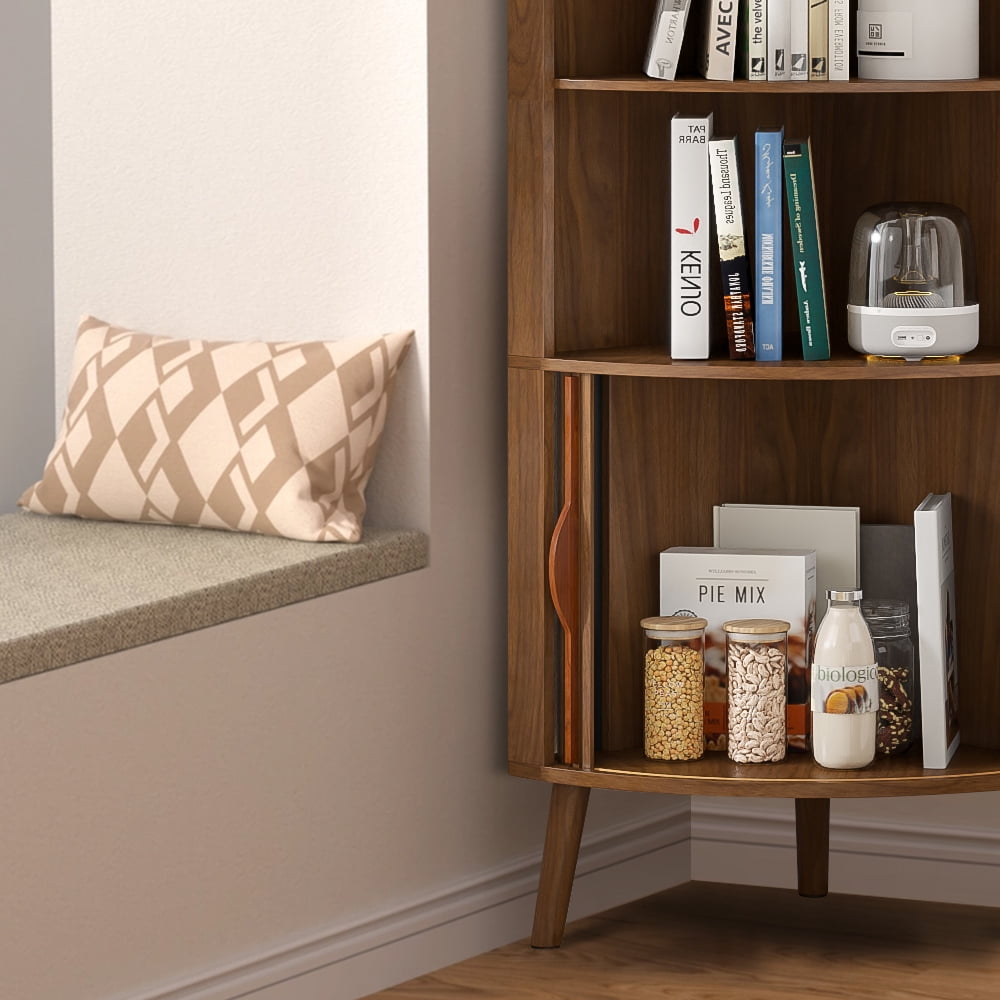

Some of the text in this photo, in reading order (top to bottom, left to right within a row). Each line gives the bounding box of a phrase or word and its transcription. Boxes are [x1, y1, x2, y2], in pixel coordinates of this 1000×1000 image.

[715, 0, 733, 56] AVEC
[752, 27, 763, 44] the
[698, 585, 766, 604] PIE MIX
